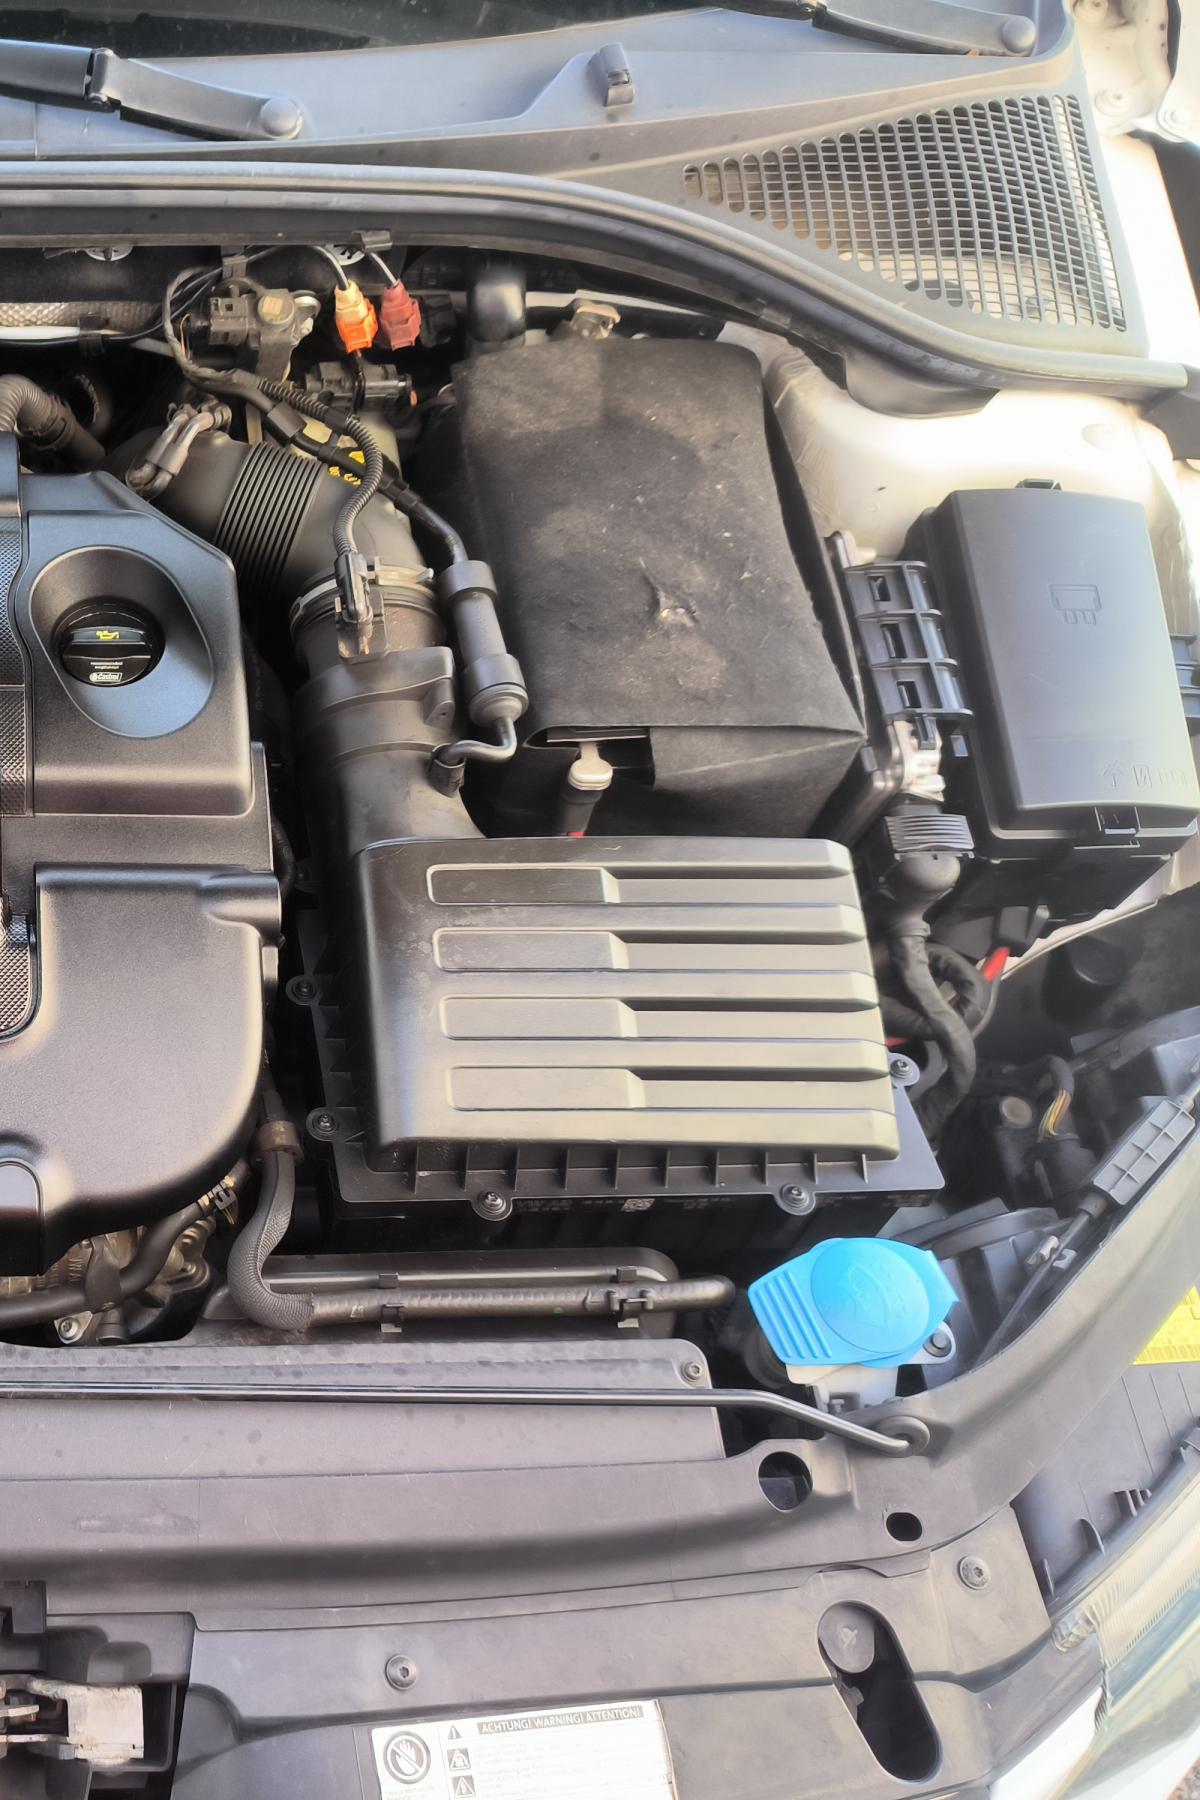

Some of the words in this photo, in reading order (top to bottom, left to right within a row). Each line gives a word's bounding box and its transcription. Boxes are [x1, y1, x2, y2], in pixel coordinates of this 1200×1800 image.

[481, 1717, 532, 1734] ACHTUNG!
[534, 1712, 583, 1728] WARNING!
[586, 1707, 640, 1722] ATTENTION!
